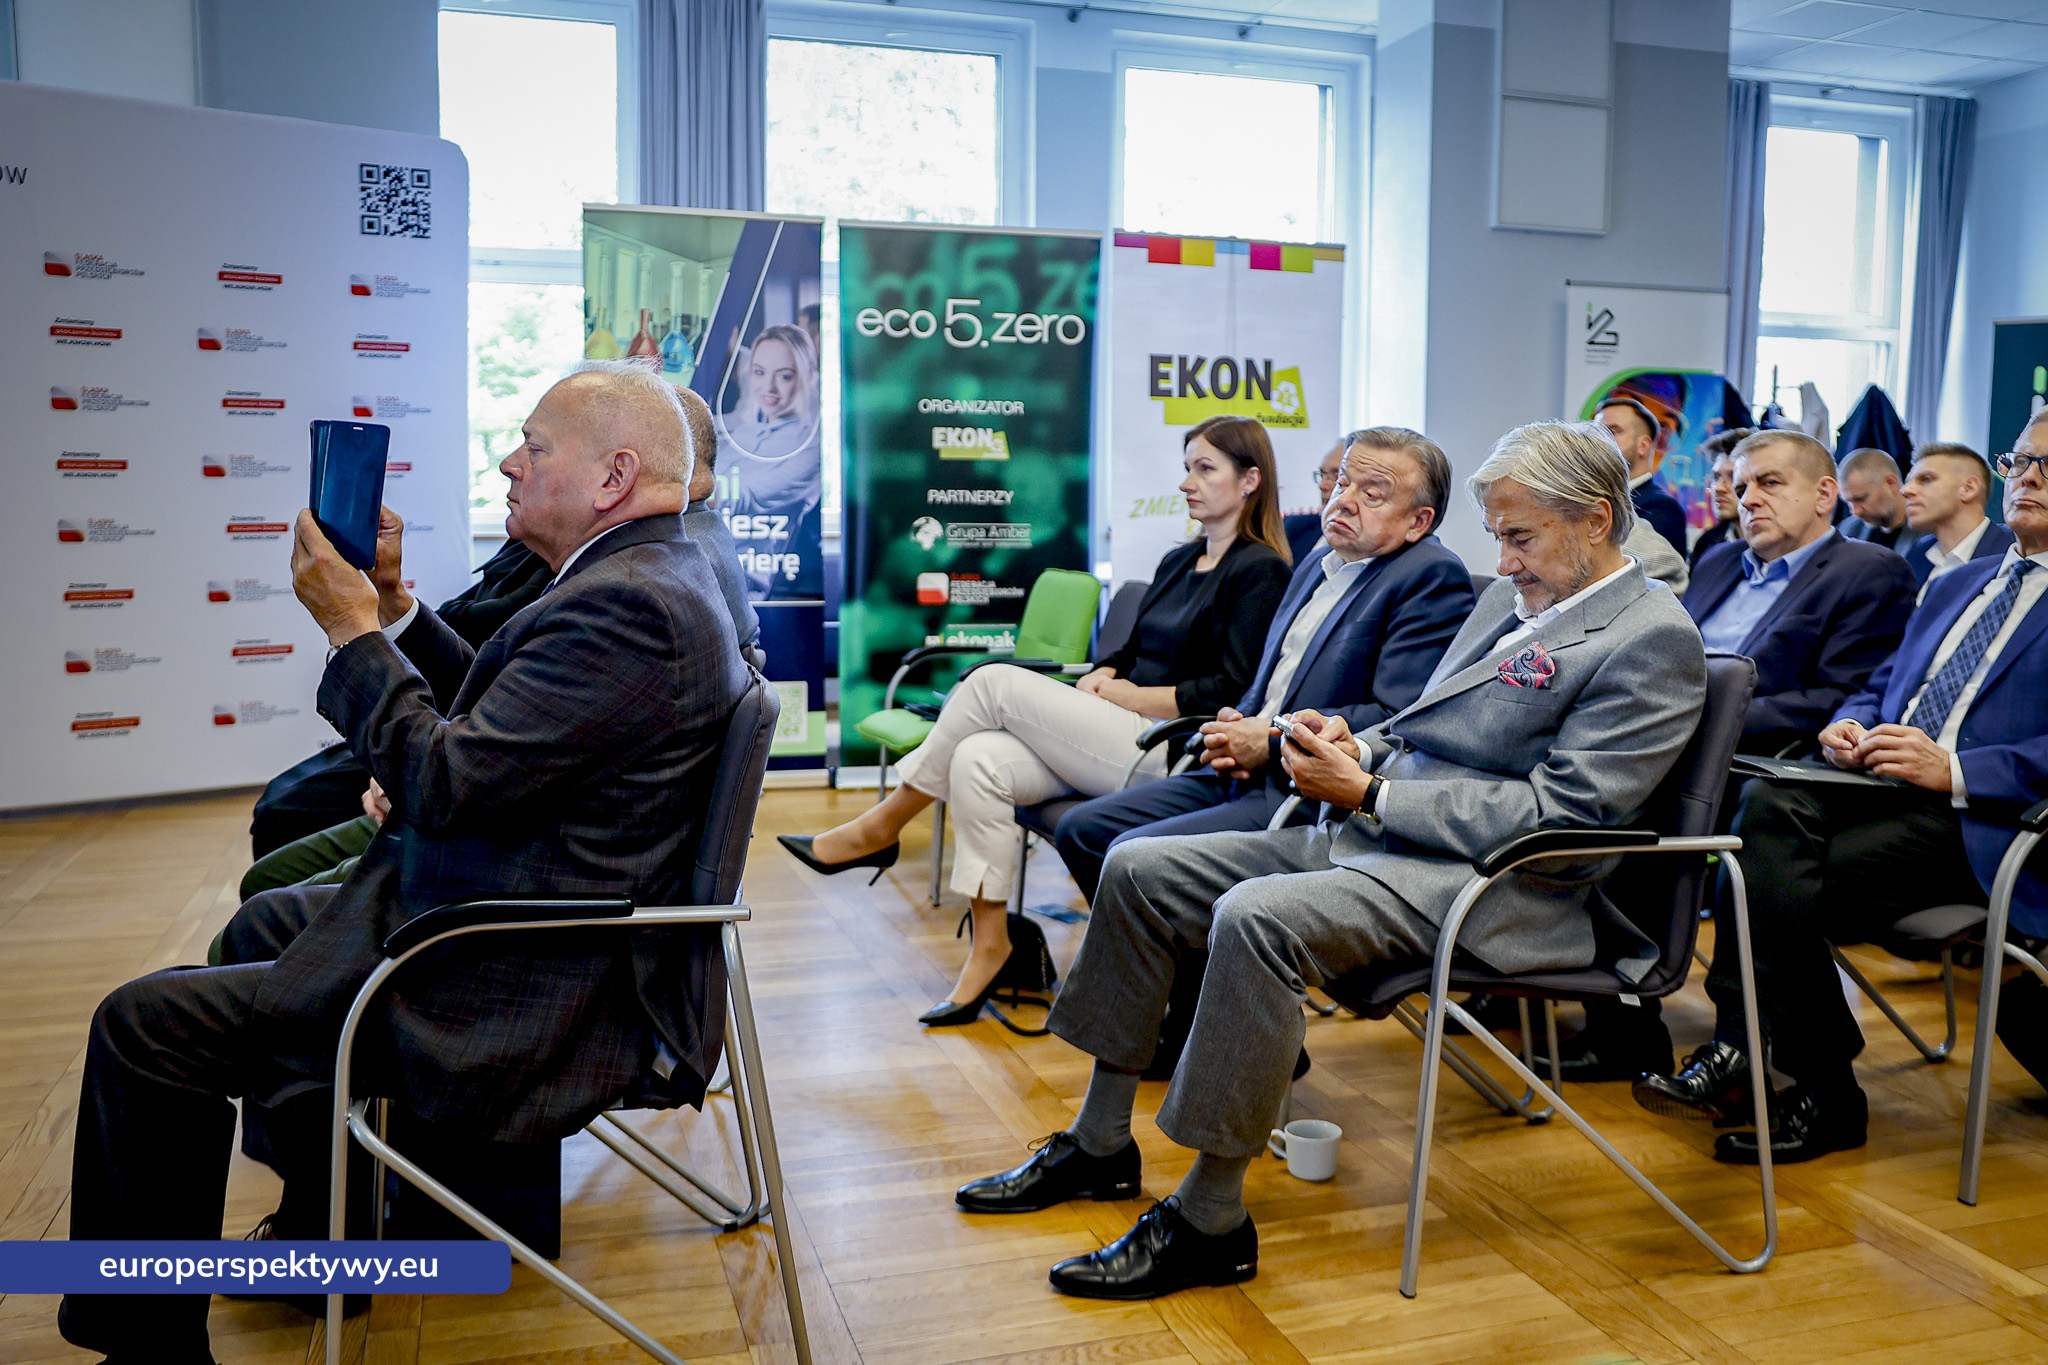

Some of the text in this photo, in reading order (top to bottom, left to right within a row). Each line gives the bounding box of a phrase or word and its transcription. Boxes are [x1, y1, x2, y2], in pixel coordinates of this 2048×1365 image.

[0, 165, 28, 185] W
[1149, 354, 1273, 401] EKON
[918, 398, 1025, 416] ORGANIZATOR
[932, 426, 994, 449] EKON
[927, 489, 1015, 505] PARTNERZY
[946, 524, 1031, 541] Grupa Amber
